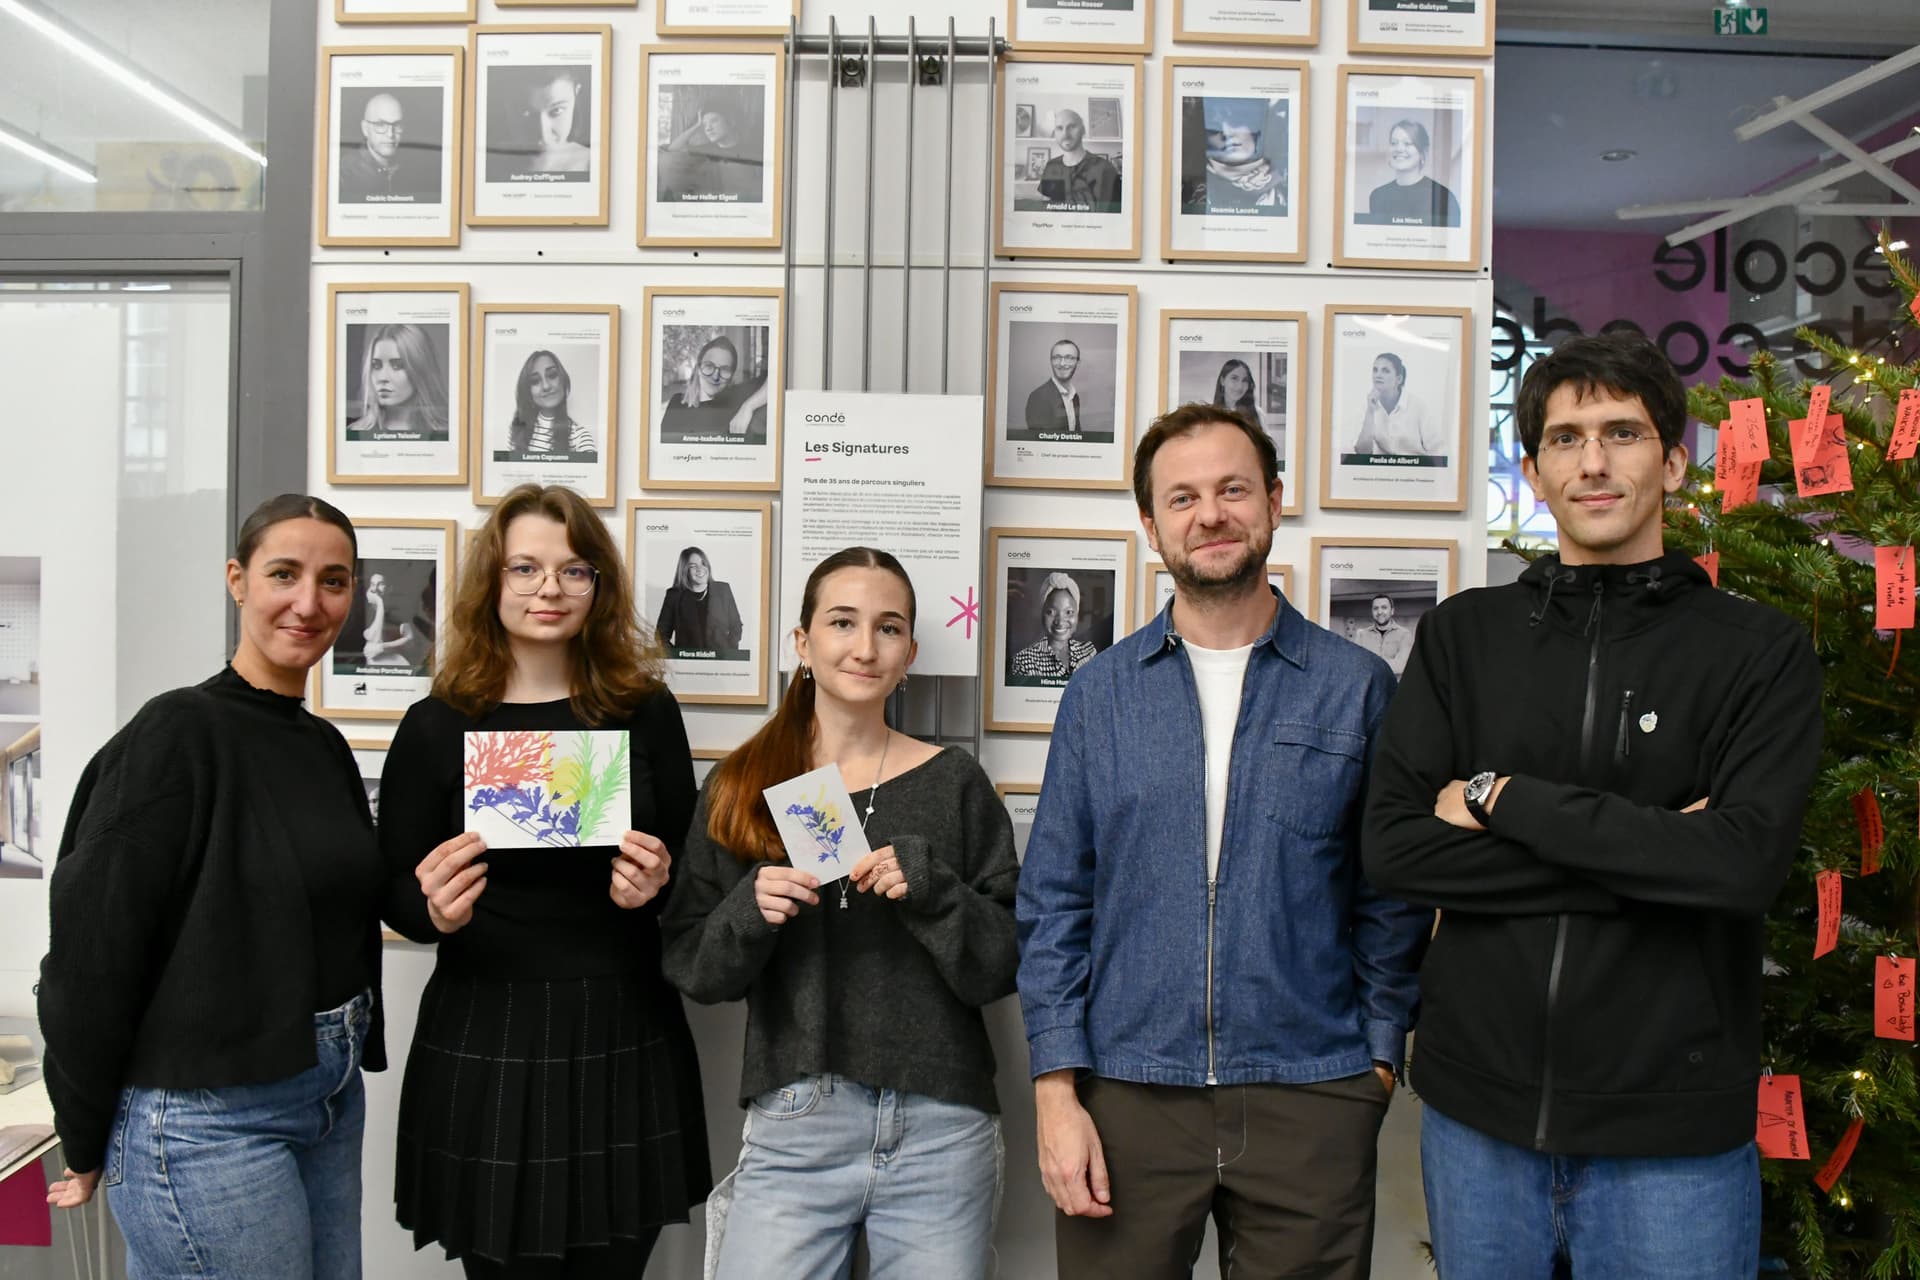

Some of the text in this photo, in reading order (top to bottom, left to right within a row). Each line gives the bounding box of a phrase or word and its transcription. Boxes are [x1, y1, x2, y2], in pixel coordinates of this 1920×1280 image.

[805, 411, 846, 423] condé
[805, 441, 910, 457] Les Signatures
[861, 479, 891, 487] parcours
[892, 479, 925, 488] singuliers
